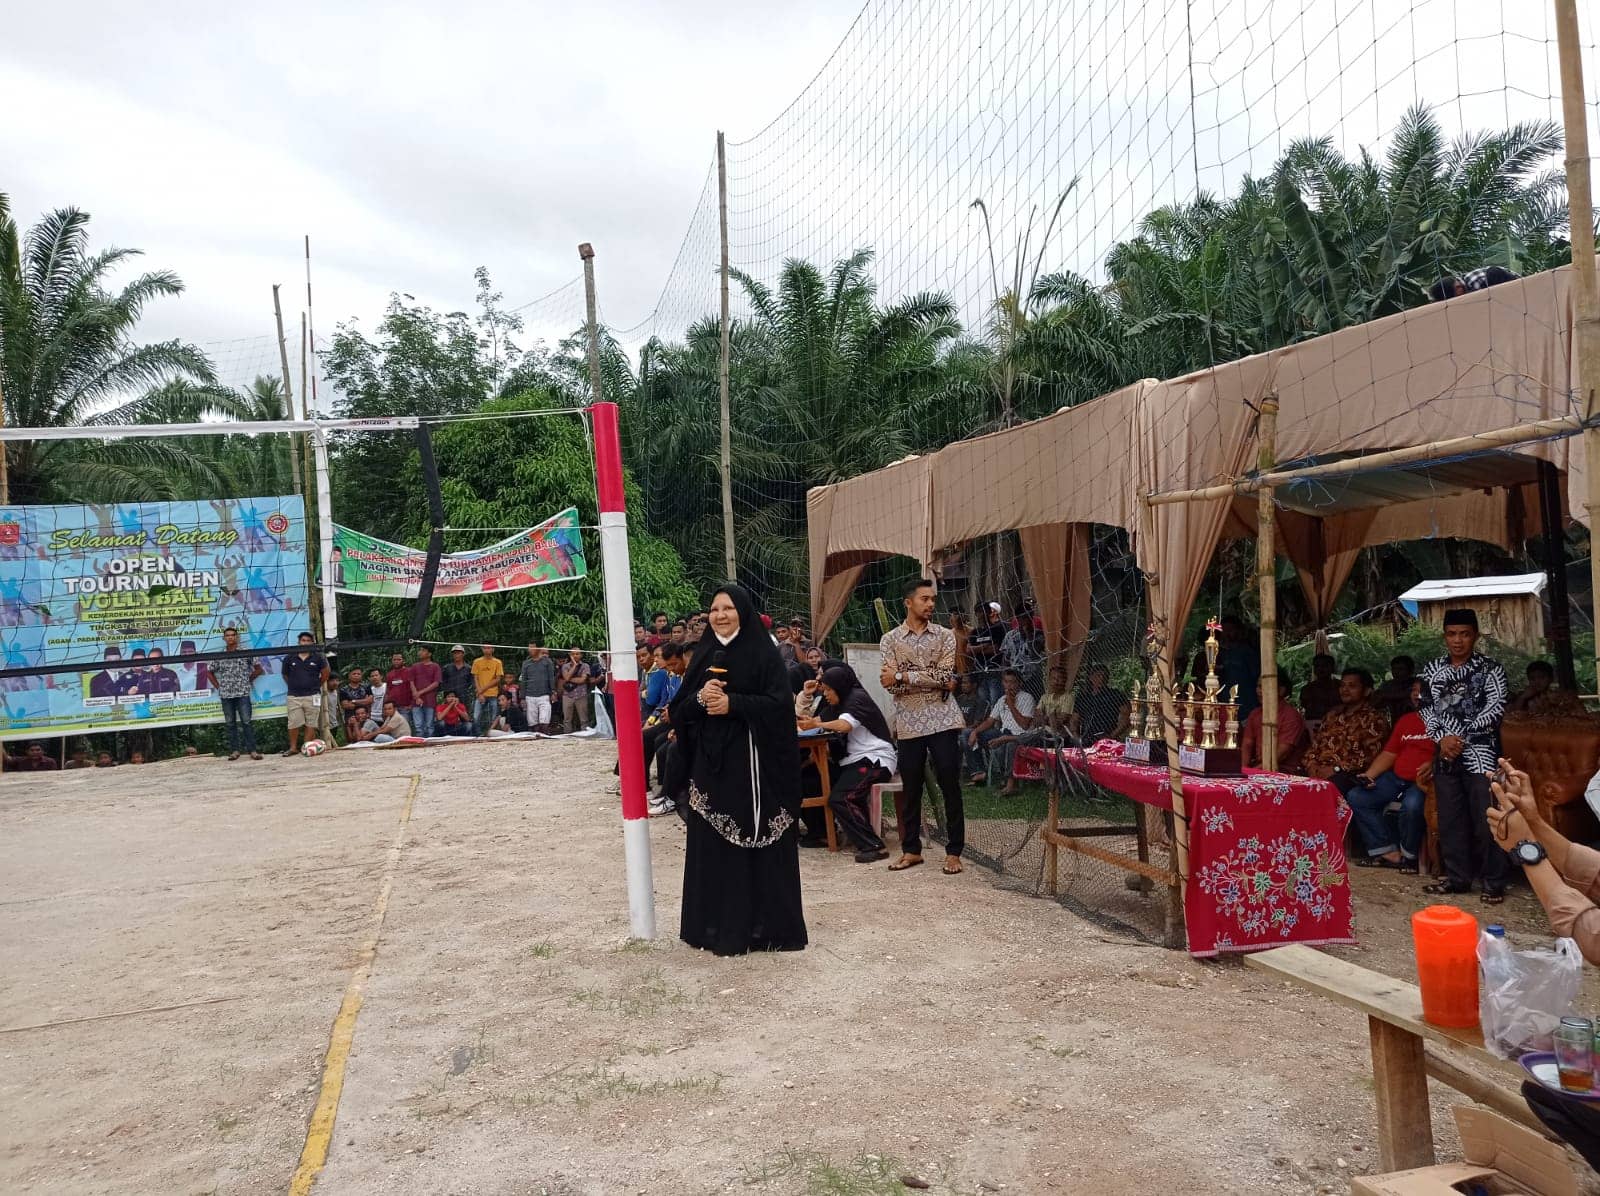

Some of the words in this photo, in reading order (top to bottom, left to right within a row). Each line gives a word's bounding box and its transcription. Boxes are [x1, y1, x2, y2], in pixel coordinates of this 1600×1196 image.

[49, 529, 146, 549] Selamat
[155, 524, 238, 547] Datang
[110, 557, 174, 574] OPEN
[360, 561, 401, 574] NAGARI
[443, 567, 478, 577] ANTAR
[482, 553, 539, 573] KABUPATEN
[63, 571, 220, 594] TOURNAMEN
[151, 618, 203, 628] KABUPATEN
